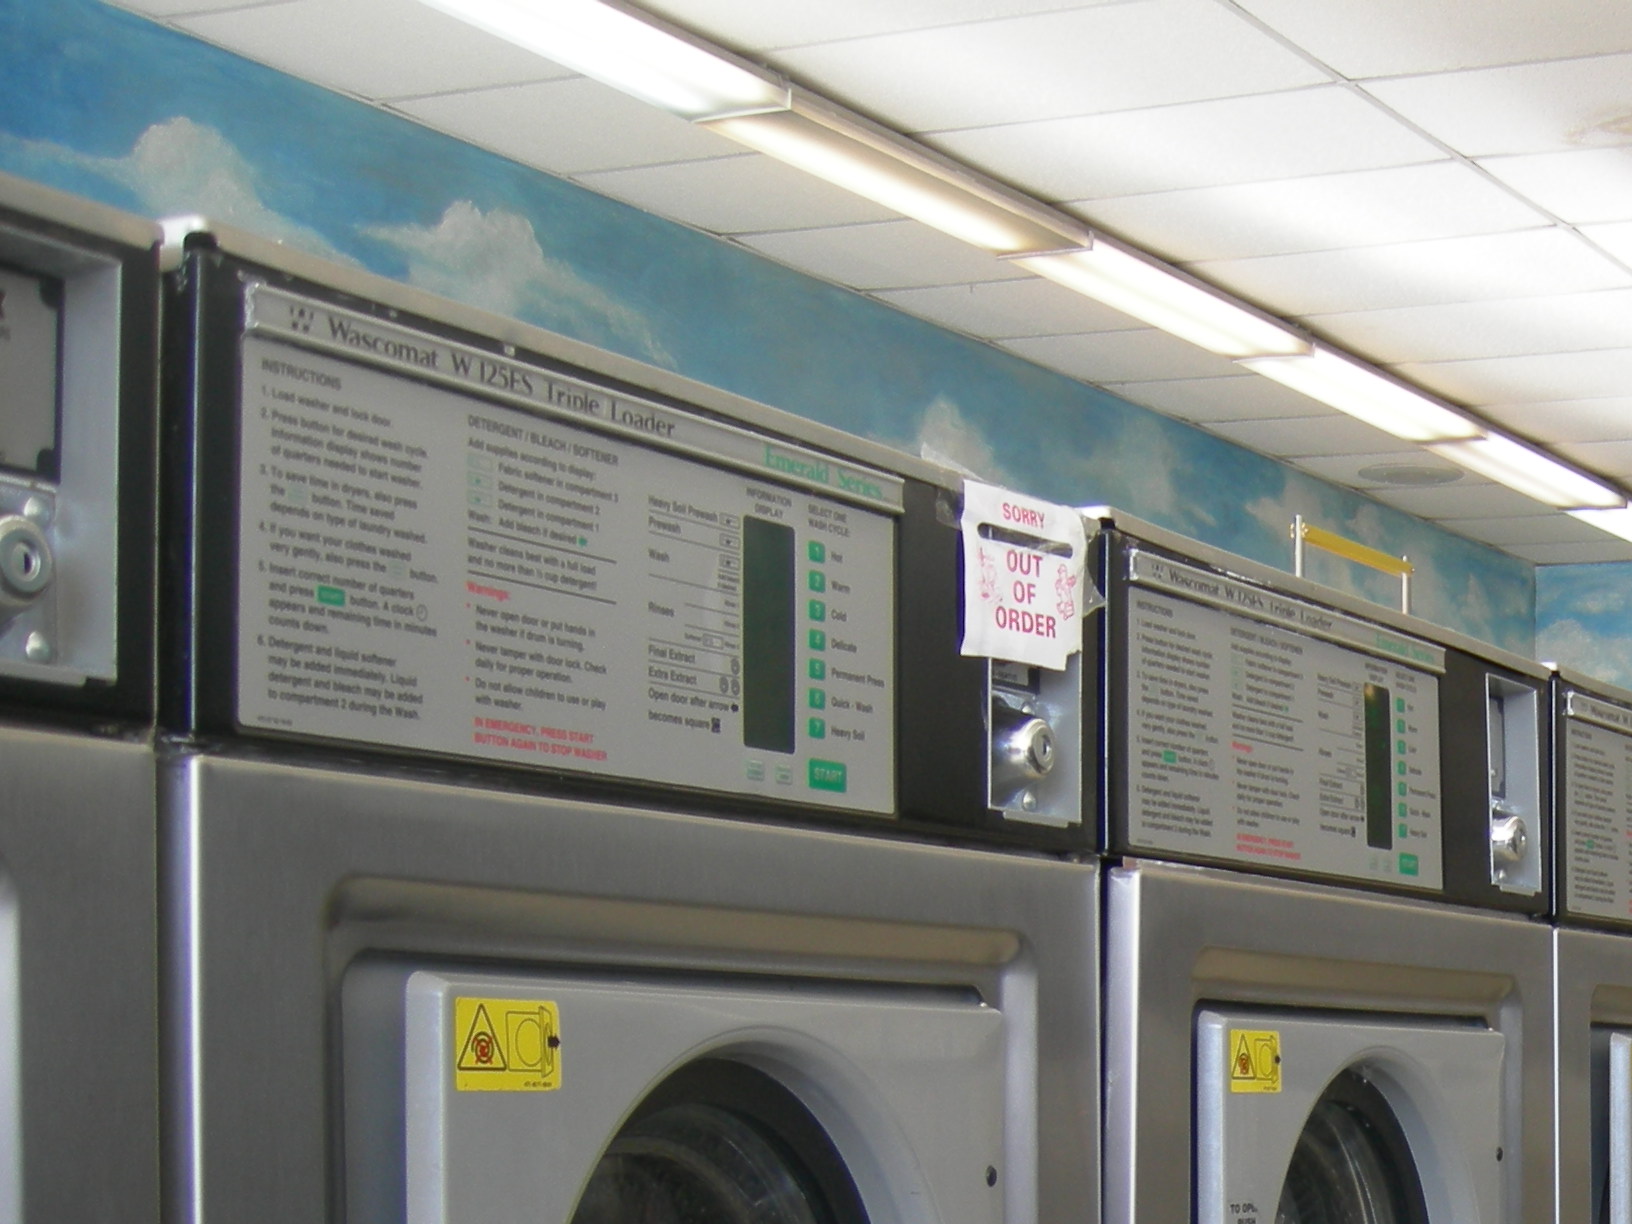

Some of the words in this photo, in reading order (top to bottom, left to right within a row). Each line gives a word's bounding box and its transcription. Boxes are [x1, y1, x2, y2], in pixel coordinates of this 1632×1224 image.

[261, 356, 341, 391] INSTRUCTIONS
[328, 315, 439, 370] Wascomat
[547, 378, 600, 415] Triple
[610, 399, 676, 438] Loader
[468, 414, 522, 440] DETERGENT
[530, 431, 565, 452] BLEACH
[573, 443, 618, 466] SOFTENER
[763, 443, 829, 484] Emerald
[746, 486, 791, 508] INFORMATION
[754, 502, 782, 520] DISPLAY
[808, 504, 831, 519] SELECT
[833, 510, 846, 523] ONE
[1002, 503, 1045, 528] SORRY
[808, 517, 827, 532] WASH
[830, 550, 842, 564] Hot
[1006, 550, 1043, 577] OUT
[831, 580, 850, 594] Warm
[1013, 581, 1036, 604] OF
[831, 608, 846, 622] Cold
[996, 606, 1056, 638] ORDER
[1301, 608, 1333, 629] Loader
[648, 644, 666, 658] Final
[668, 648, 695, 664] Extract
[831, 637, 856, 653] Delicate
[648, 665, 668, 680] Extra
[670, 669, 696, 685] Extract
[831, 667, 865, 684] Permanent
[867, 674, 884, 688] Press
[648, 687, 668, 703] Open
[670, 691, 687, 704] door
[689, 695, 706, 707] after
[709, 700, 728, 711] arrow
[831, 696, 849, 710] Quick
[856, 701, 872, 712] Wash
[648, 709, 682, 724] becomes
[474, 715, 483, 727] IN
[540, 725, 566, 740] PRESS
[569, 730, 593, 744] START
[831, 725, 851, 740] Heavy
[853, 729, 865, 741] Soil
[474, 731, 508, 747] BUTTON
[510, 736, 536, 751] AGAIN
[539, 741, 549, 753] TO
[551, 742, 571, 756] STOP
[574, 746, 607, 761] WASHER
[813, 767, 841, 784] START
